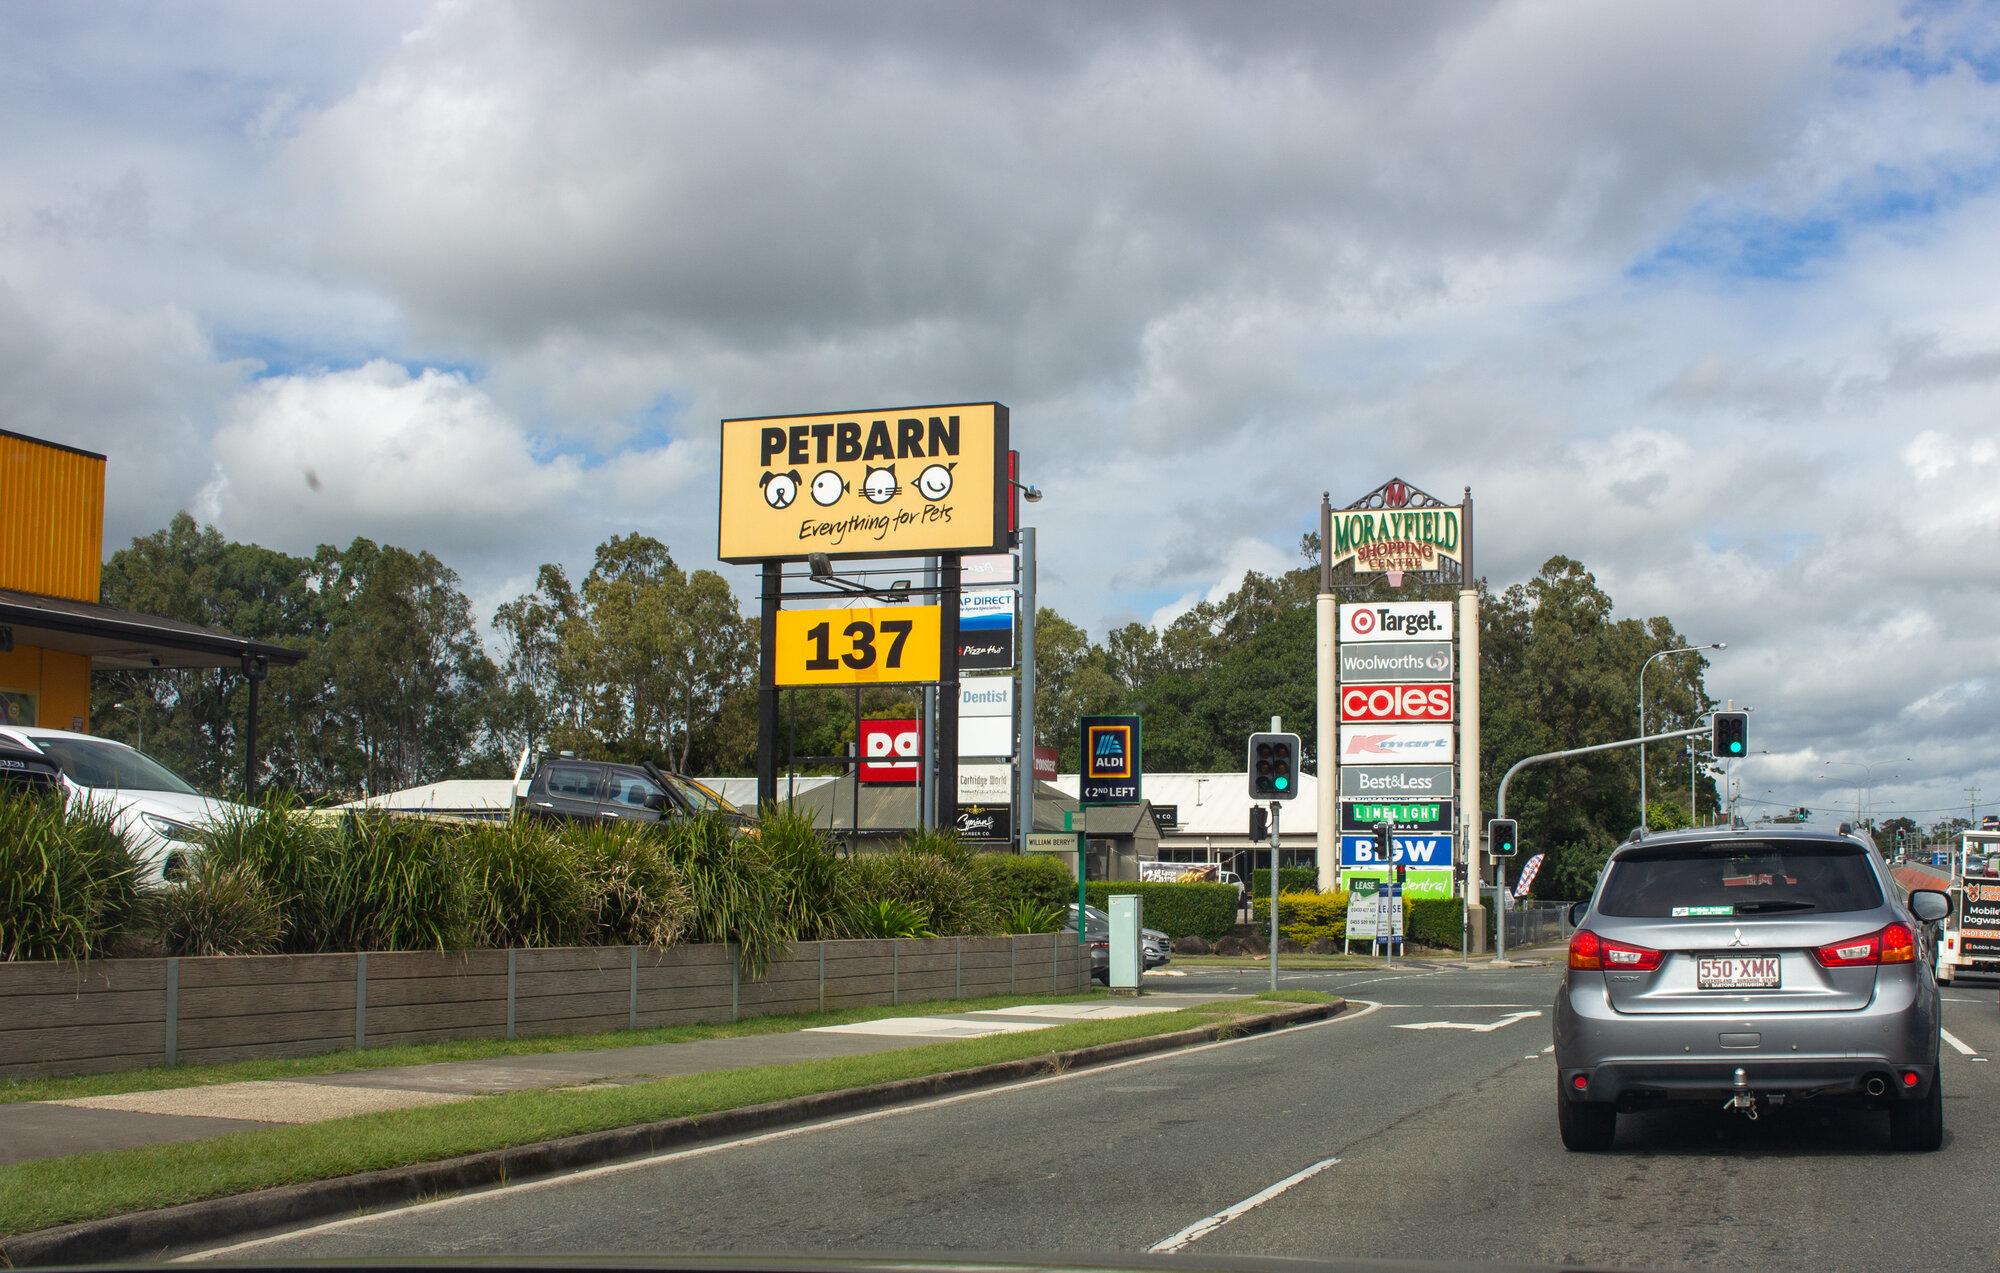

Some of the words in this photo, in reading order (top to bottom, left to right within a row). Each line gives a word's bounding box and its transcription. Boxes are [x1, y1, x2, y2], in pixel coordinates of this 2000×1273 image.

[760, 415, 960, 467] PETBARN
[1387, 482, 1406, 507] M
[798, 514, 890, 546] Everything
[892, 507, 922, 533] for
[921, 504, 954, 524] Pets
[1334, 511, 1458, 555] MORAYFIELD
[1357, 541, 1434, 562] SHOPPING
[1368, 557, 1422, 568] CENTRE
[973, 596, 1012, 606] DIRECT
[805, 620, 913, 671] 137
[963, 645, 986, 656] Pizza
[987, 645, 1004, 655] Hut
[1343, 654, 1424, 671] Woolworths
[963, 690, 1007, 704] Dentist
[1343, 686, 1449, 717] coles
[1345, 734, 1448, 755] Kmart
[1035, 758, 1056, 772] rooster
[1095, 757, 1123, 767] ALDI
[960, 775, 988, 787] Cartridge
[990, 775, 1007, 785] World
[1359, 773, 1432, 790] Best&Less
[1109, 787, 1136, 797] LEFT
[1355, 807, 1438, 819] LIMELIGHT
[1404, 840, 1437, 862] W
[1355, 881, 1375, 890] LEASE
[1402, 877, 1448, 893] Central
[1610, 975, 1641, 983] ASX
